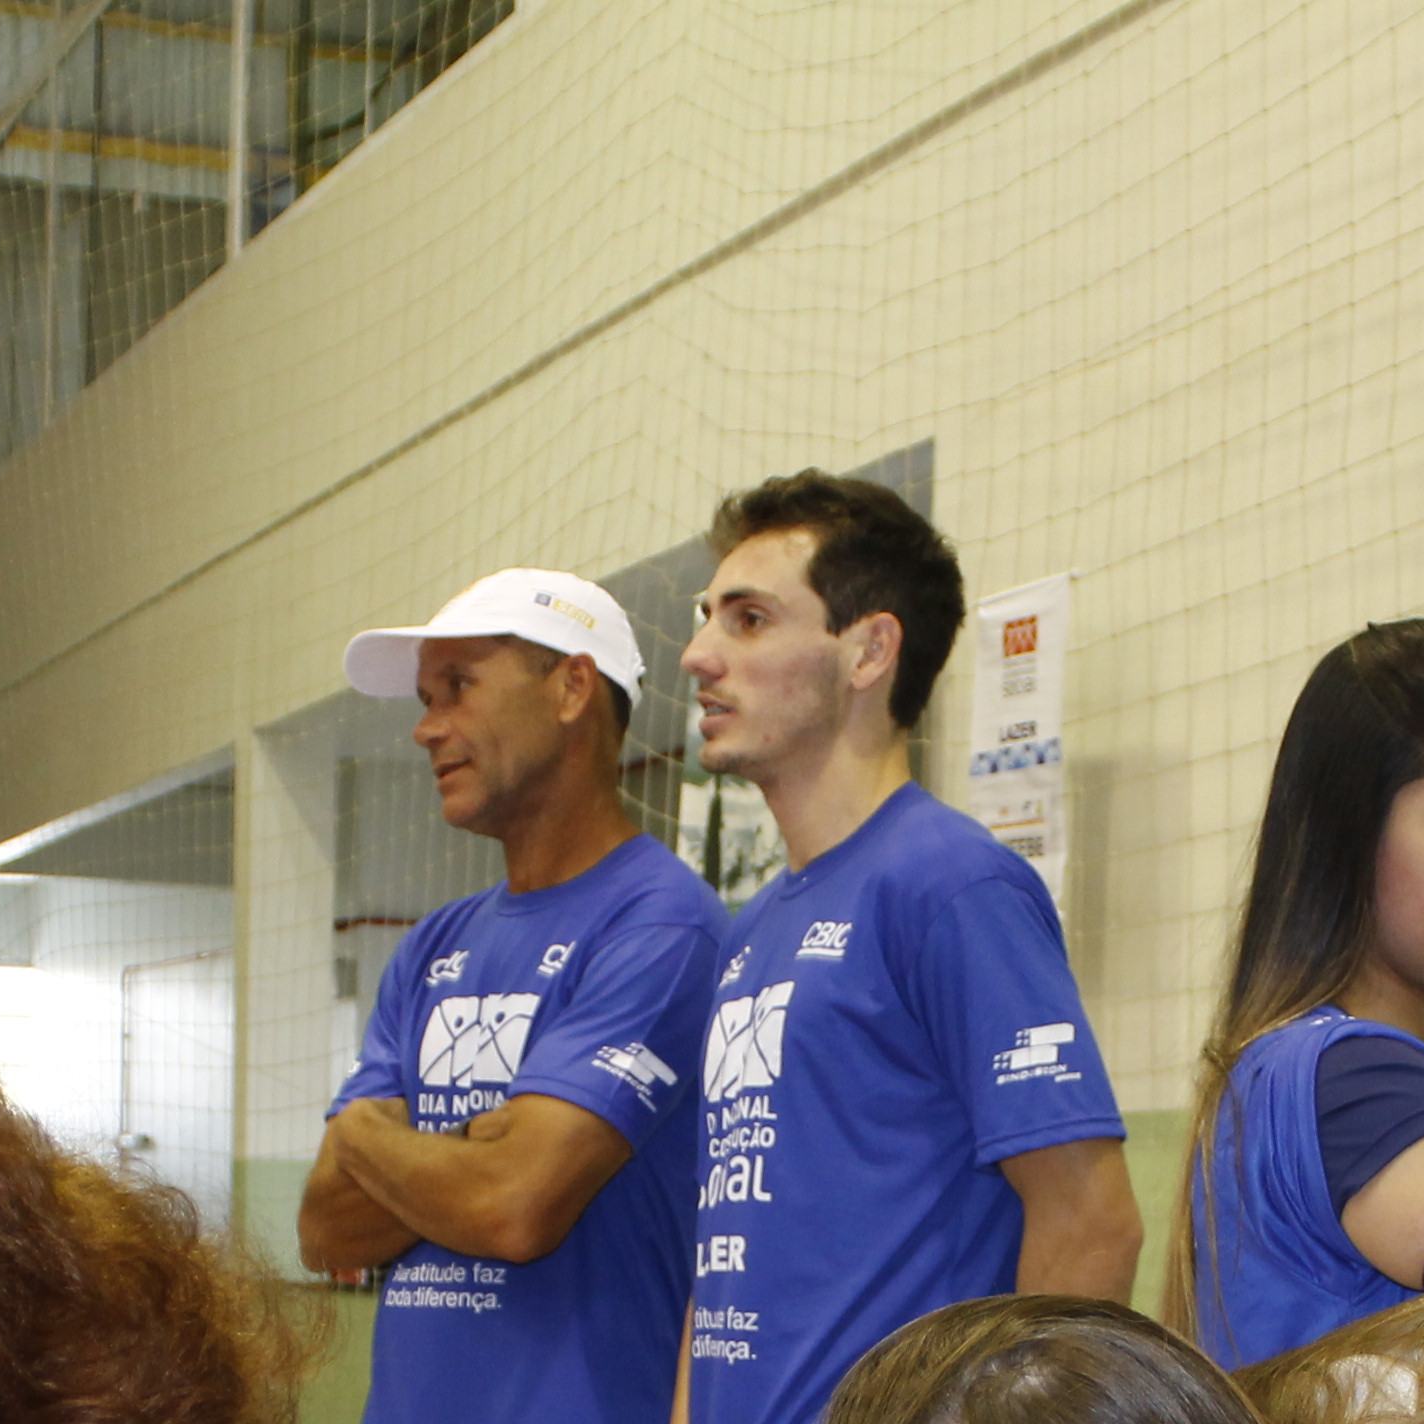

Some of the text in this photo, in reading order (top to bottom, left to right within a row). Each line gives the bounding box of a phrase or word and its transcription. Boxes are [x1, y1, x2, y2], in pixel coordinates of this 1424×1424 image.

[803, 920, 853, 949] CBIC
[418, 1093, 447, 1116] DIA
[409, 1262, 466, 1284] atitude
[472, 1262, 507, 1285] faz
[414, 1285, 503, 1314] diferença.
[727, 1305, 760, 1332] faz
